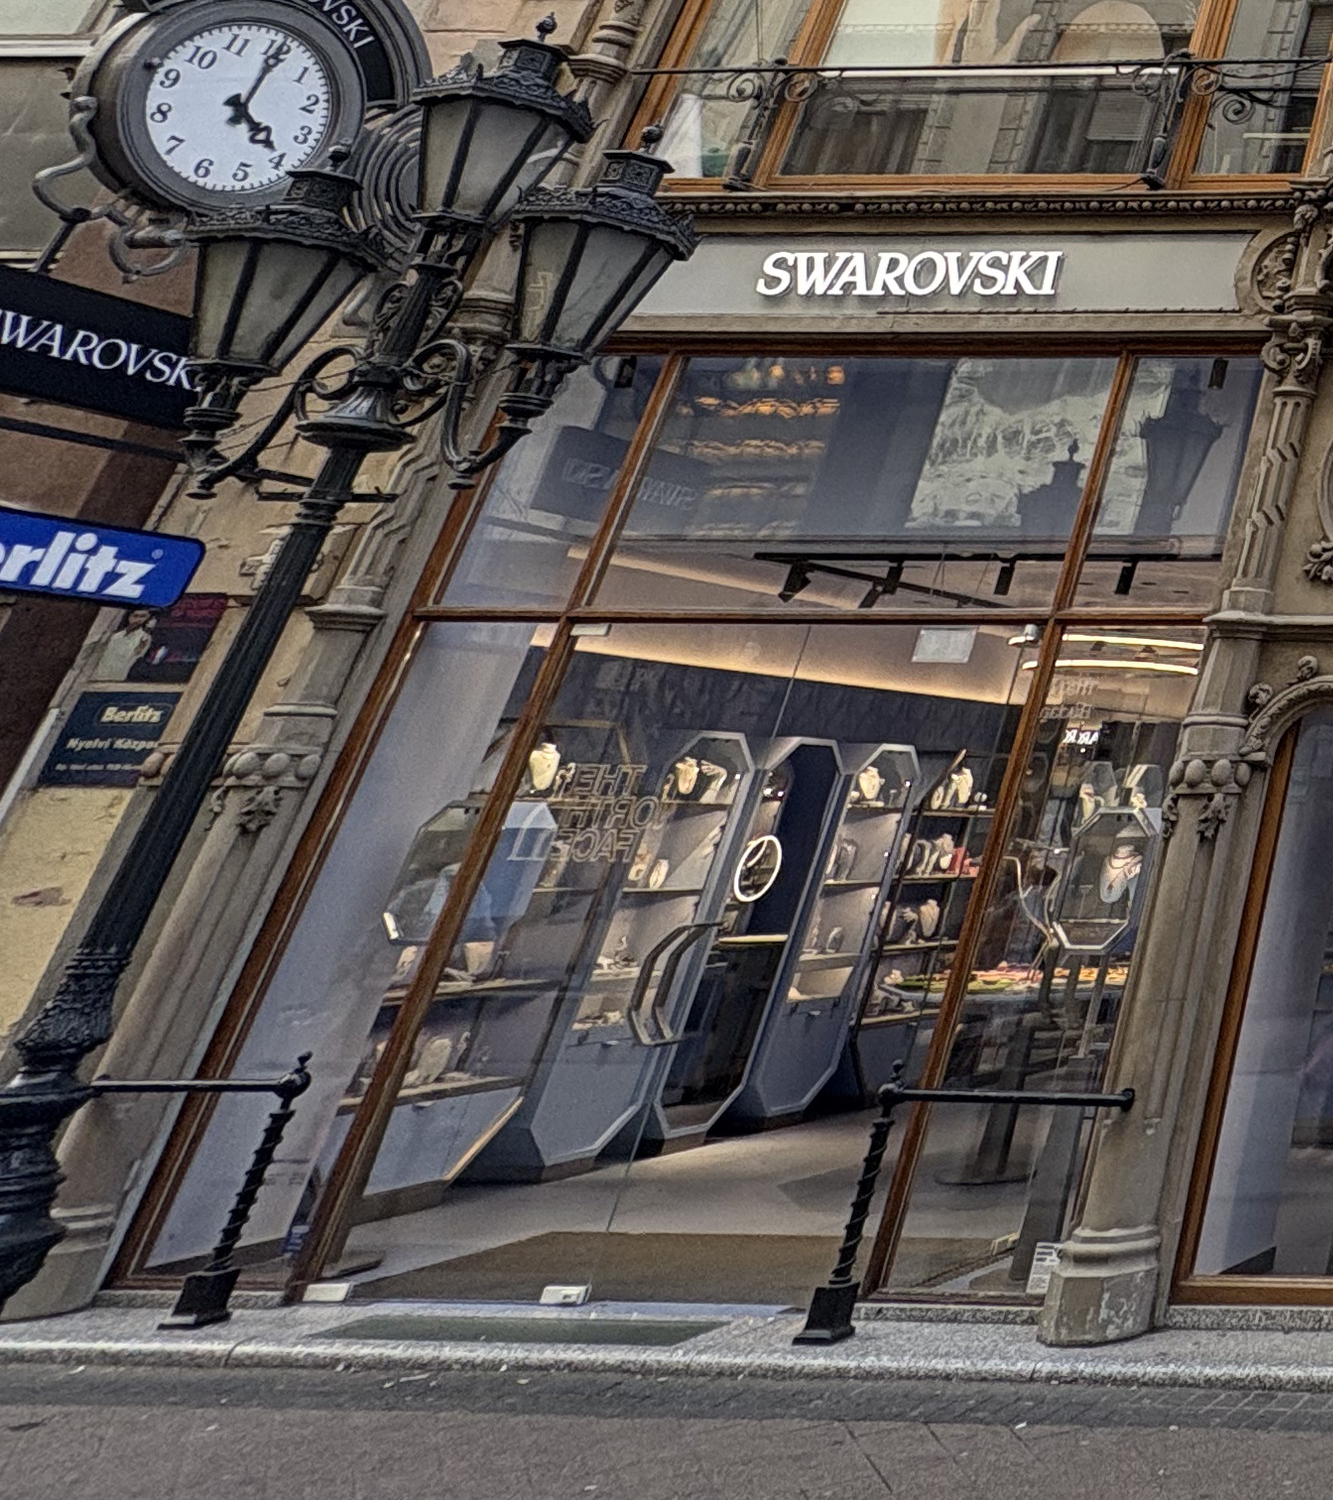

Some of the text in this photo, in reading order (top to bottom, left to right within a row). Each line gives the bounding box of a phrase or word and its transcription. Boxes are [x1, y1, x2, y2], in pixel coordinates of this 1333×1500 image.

[222, 34, 250, 57] 11
[185, 45, 217, 70] 10
[159, 68, 181, 88] 9
[293, 66, 309, 85] 1
[150, 102, 173, 124] 8
[300, 94, 320, 114] 2
[166, 135, 185, 156] 7
[293, 125, 312, 145] 3
[194, 158, 214, 179] 6
[268, 152, 288, 171] 4
[232, 162, 253, 183] 5
[756, 251, 1063, 296] SWAROVSKI
[0, 308, 203, 392] WAROVSK
[0, 531, 156, 598] rlitz
[101, 705, 164, 723] Berlitz
